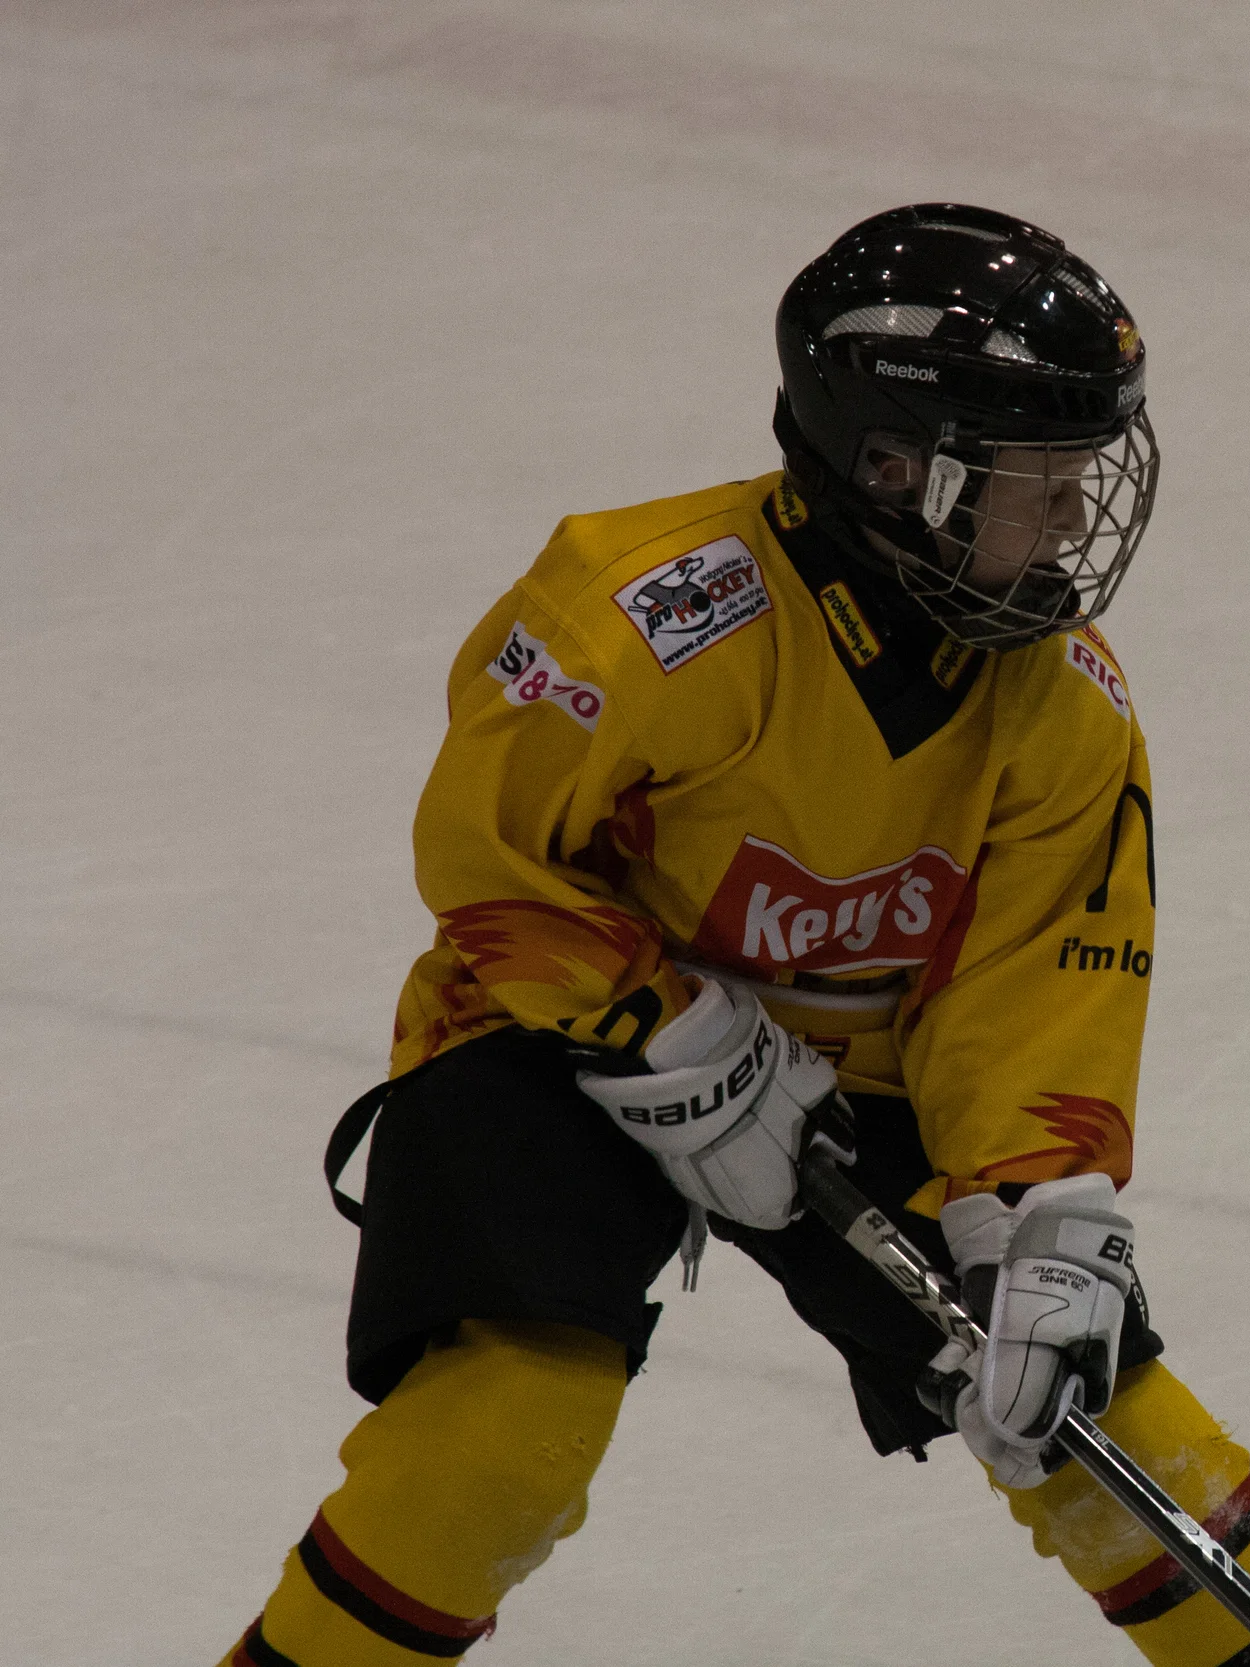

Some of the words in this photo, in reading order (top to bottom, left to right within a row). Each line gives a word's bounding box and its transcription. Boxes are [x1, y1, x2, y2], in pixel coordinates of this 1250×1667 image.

[875, 359, 940, 383] Reebok
[822, 588, 874, 661] prohockey.at
[1073, 642, 1130, 706] RIC
[1058, 936, 1115, 971] i'm
[1120, 939, 1154, 981] lo
[620, 1020, 772, 1126] BAUER
[1039, 1275, 1067, 1286] ONE
